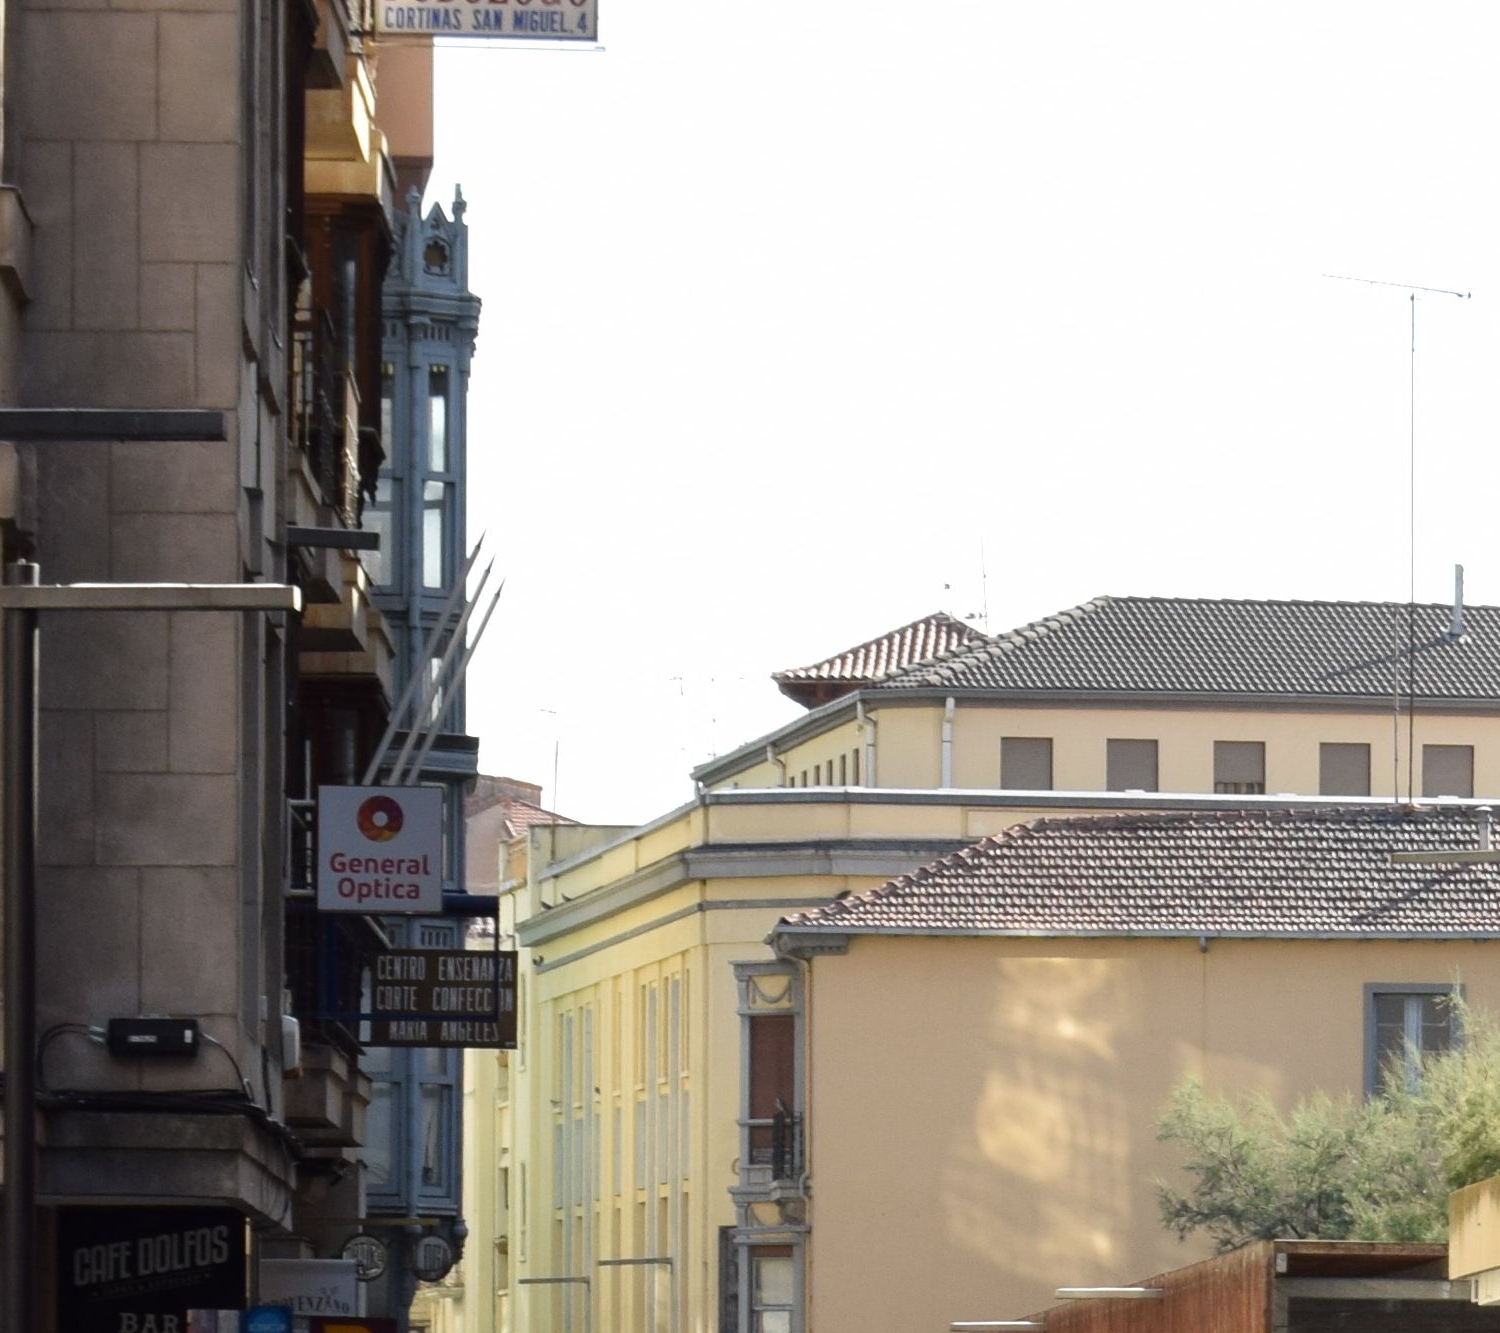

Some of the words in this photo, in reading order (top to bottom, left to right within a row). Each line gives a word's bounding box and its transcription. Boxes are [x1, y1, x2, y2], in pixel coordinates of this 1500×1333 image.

[385, 8, 462, 31] CORTINAS
[472, 9, 503, 31] SAN
[577, 12, 587, 33] 4
[329, 852, 431, 876] General
[337, 877, 421, 903] Optica
[377, 955, 426, 980] CENTRO
[376, 986, 418, 1011] CORTE
[137, 1225, 230, 1277] DOLFOS
